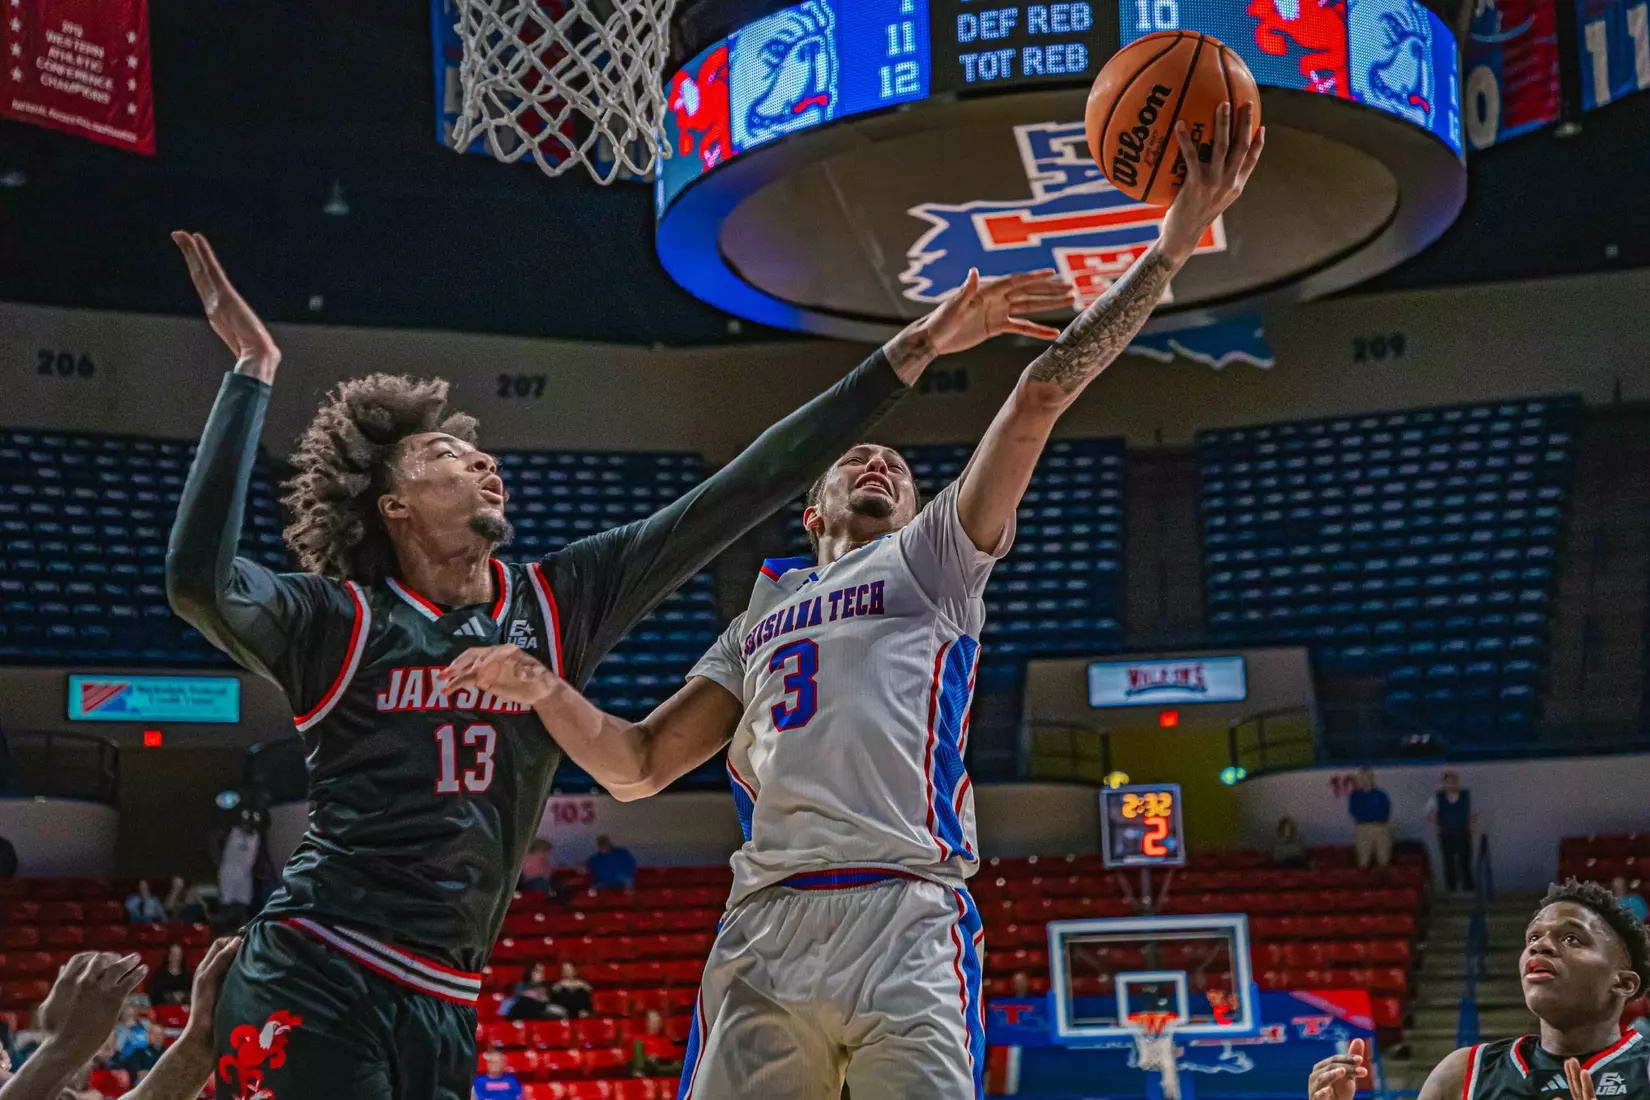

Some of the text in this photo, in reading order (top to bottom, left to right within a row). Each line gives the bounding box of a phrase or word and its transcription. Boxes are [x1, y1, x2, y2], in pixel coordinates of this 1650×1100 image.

[956, 7, 1019, 42] DEF
[1027, 2, 1093, 34] REB
[878, 43, 1089, 99] 12 TOT REB
[1112, 83, 1173, 188] Wilson
[828, 579, 885, 622] TECH
[768, 637, 820, 733] 3
[434, 722, 497, 795] 13
[1121, 792, 1173, 819] 2:32
[1142, 816, 1169, 857] 2
[1595, 1085, 1627, 1096] USA
